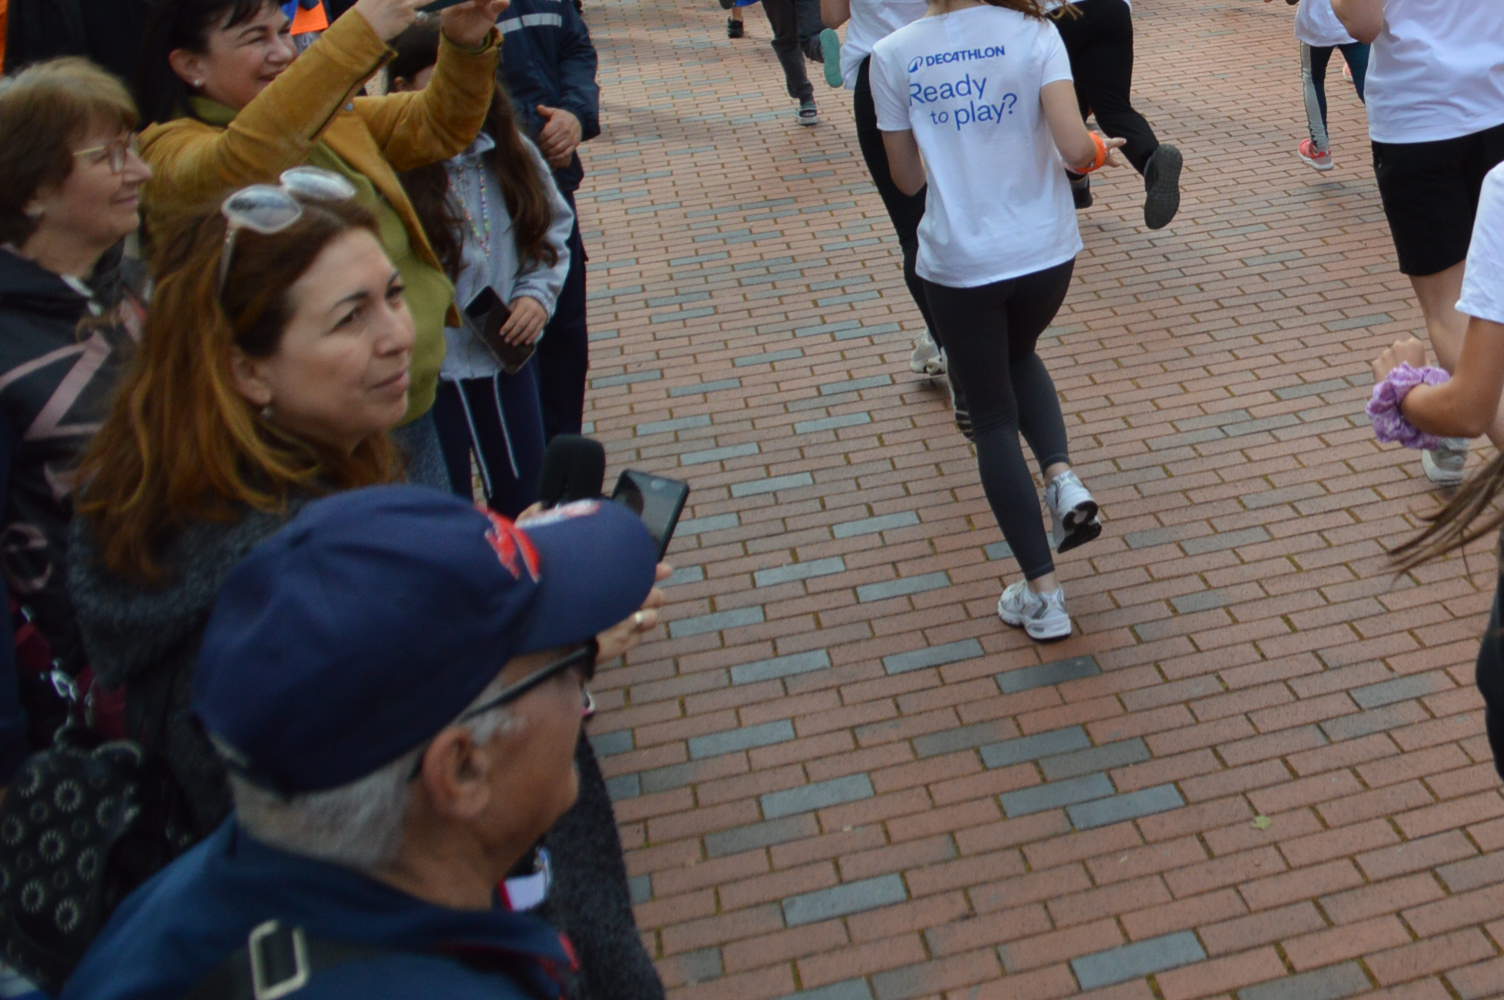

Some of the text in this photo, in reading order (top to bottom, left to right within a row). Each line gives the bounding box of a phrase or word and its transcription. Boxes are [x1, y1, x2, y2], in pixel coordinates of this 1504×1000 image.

[926, 45, 1006, 67] DECATHLON
[909, 74, 987, 107] Ready
[930, 92, 1018, 131] to play?
